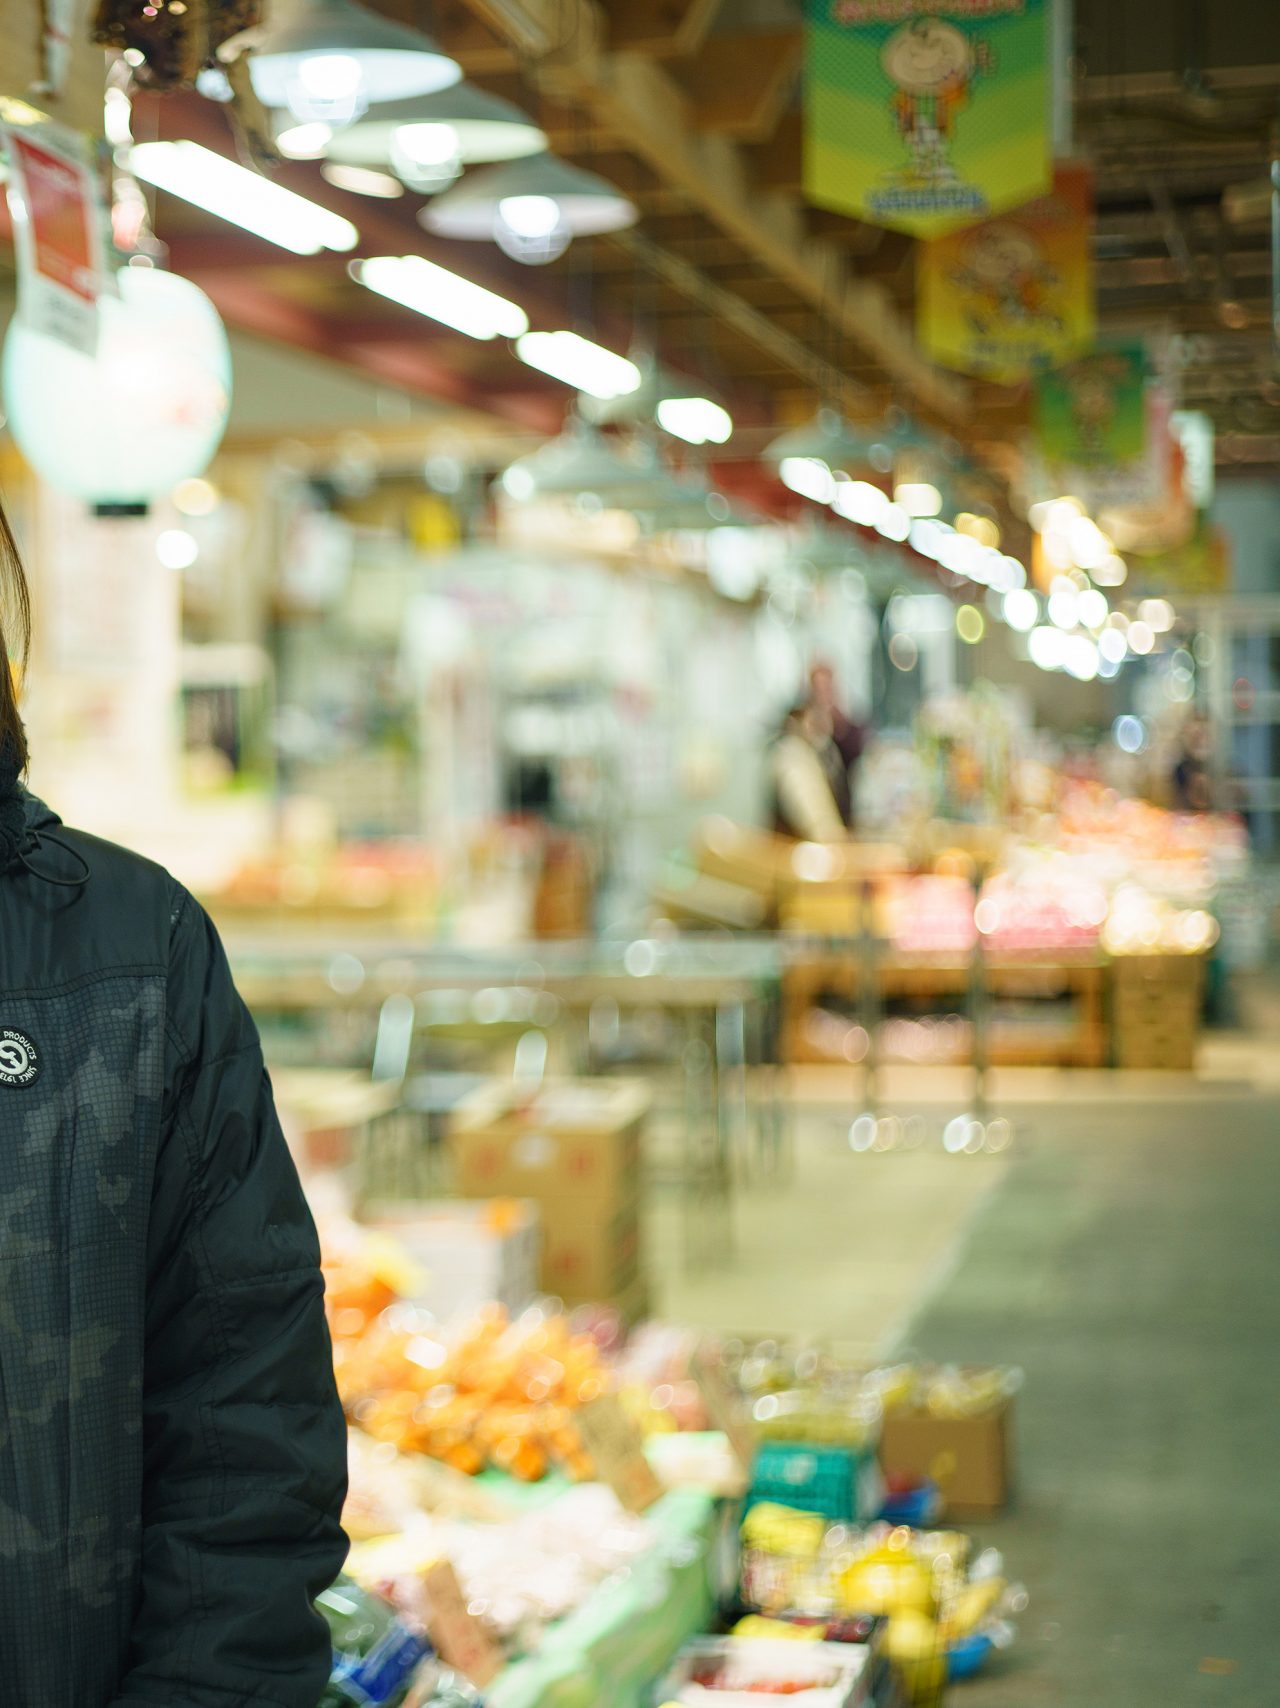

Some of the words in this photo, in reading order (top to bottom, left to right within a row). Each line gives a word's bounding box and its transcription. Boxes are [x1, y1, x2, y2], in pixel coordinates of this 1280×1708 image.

[3, 1030, 37, 1060] PRODUCTS
[0, 1072, 17, 1084] 1973
[18, 1065, 38, 1083] SINCE
